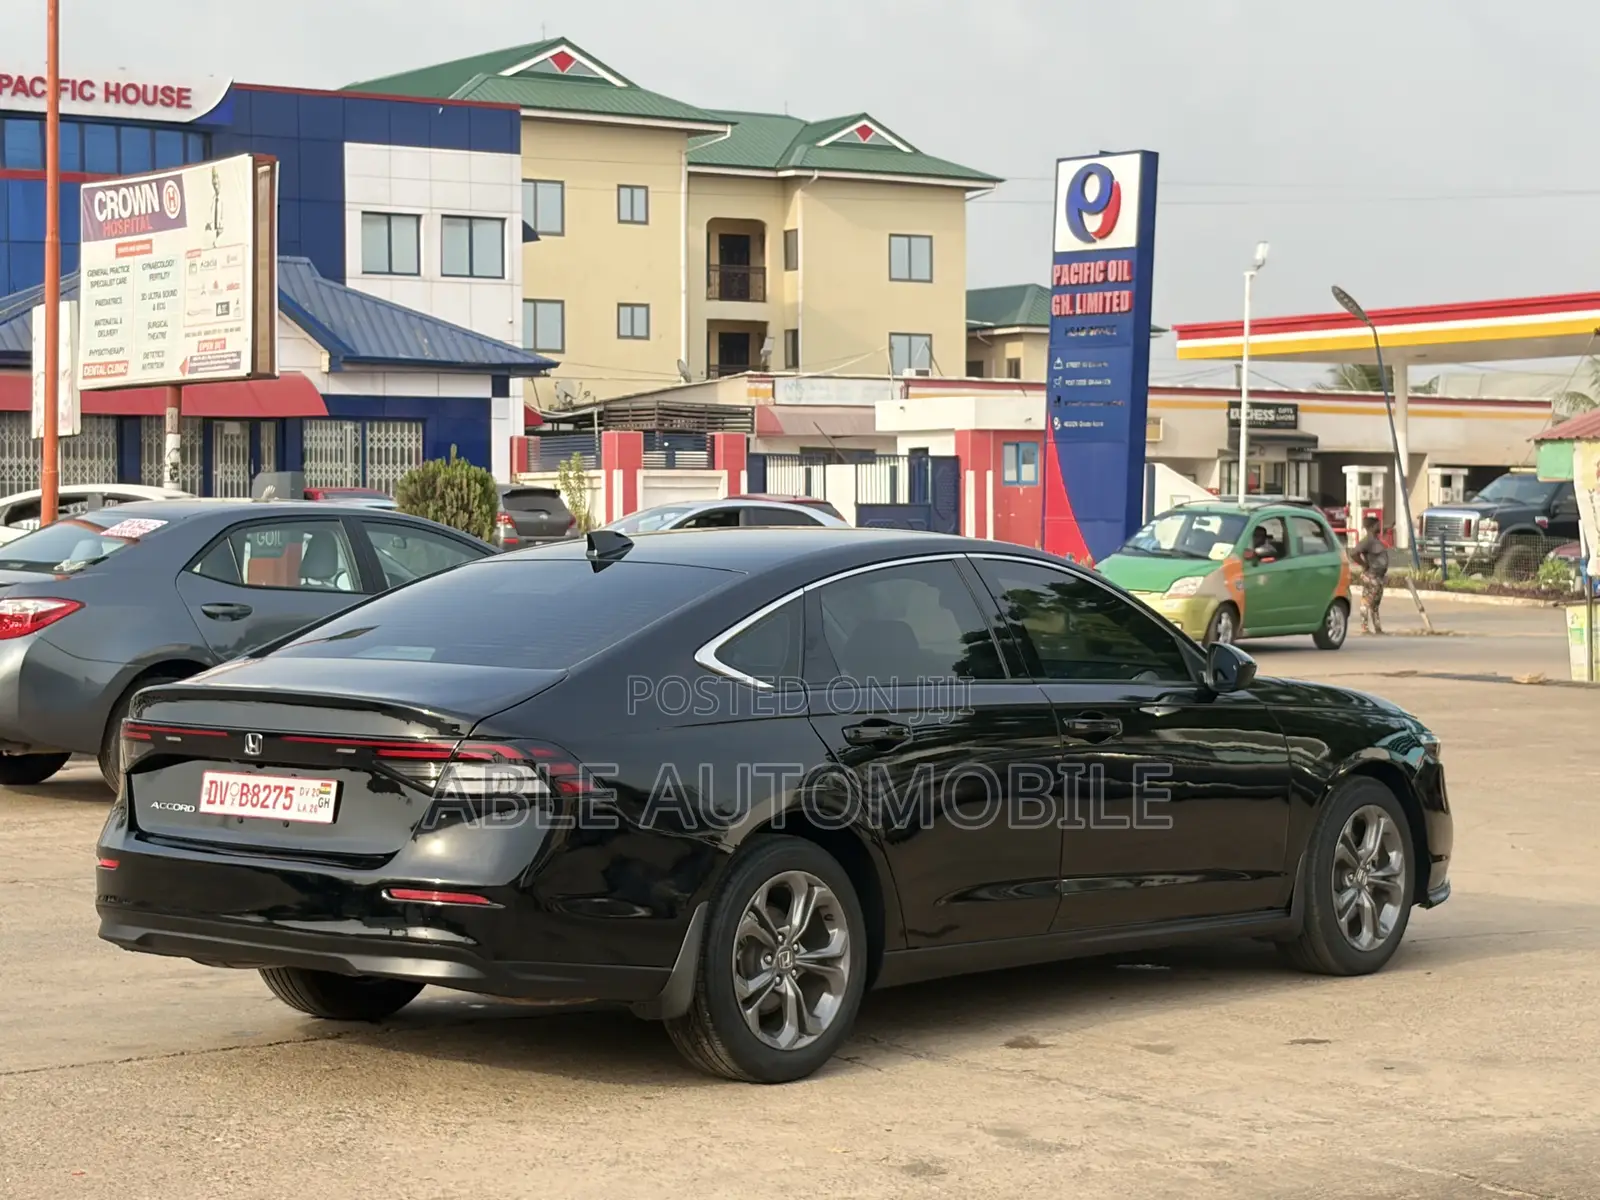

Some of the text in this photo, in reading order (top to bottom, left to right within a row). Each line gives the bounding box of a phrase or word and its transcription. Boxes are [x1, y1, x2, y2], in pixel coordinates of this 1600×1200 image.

[0, 74, 192, 109] PACFIC HOUSE
[94, 182, 160, 222] CROWN
[102, 214, 153, 237] HOSPITAL
[1053, 259, 1132, 286] PACIFIC OIL
[1051, 290, 1132, 316] GH. LIMITED
[83, 363, 127, 377] DENTAL CLINIC
[150, 801, 196, 813] ACCORD
[206, 780, 295, 811] DV B8275
[318, 797, 330, 809] GH
